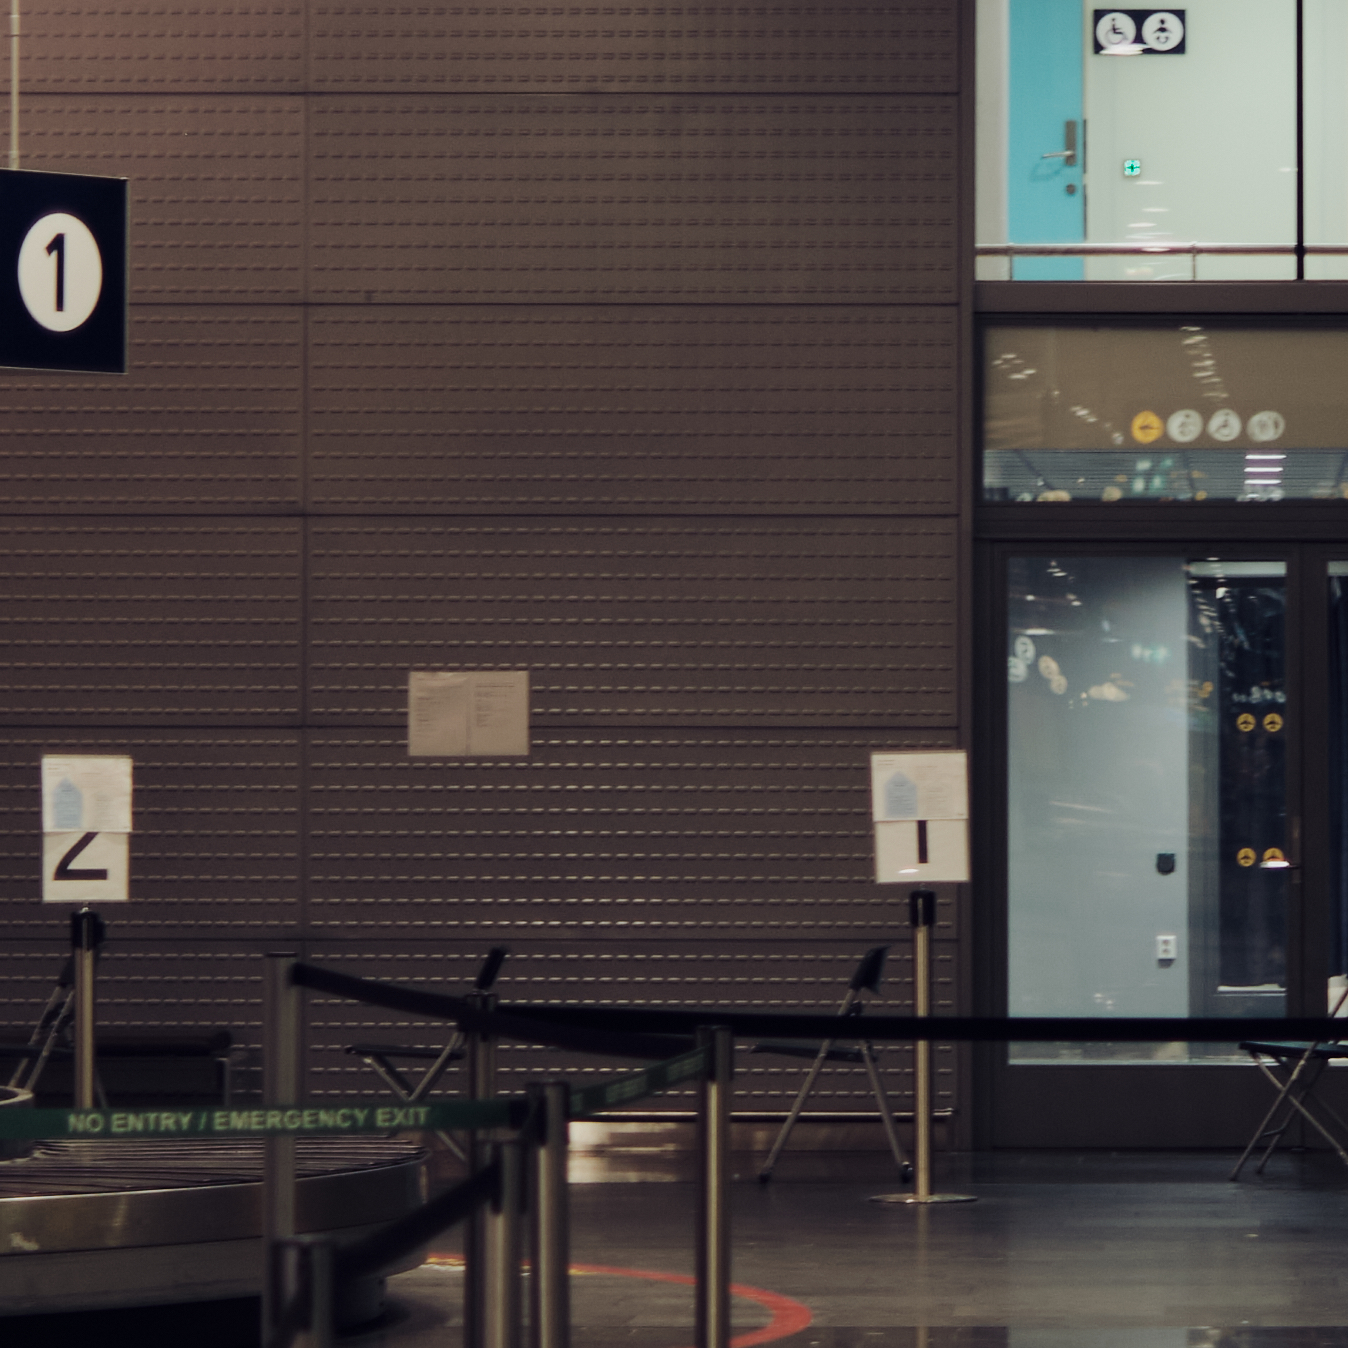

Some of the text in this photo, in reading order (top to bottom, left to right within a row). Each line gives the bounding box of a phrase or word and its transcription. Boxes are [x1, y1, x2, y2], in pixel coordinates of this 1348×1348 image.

[45, 232, 66, 312] 1
[68, 1112, 106, 1134] NO
[111, 1111, 193, 1134] ENTRY
[212, 1108, 370, 1132] EMERGENCY
[375, 1106, 432, 1127] EXIT
